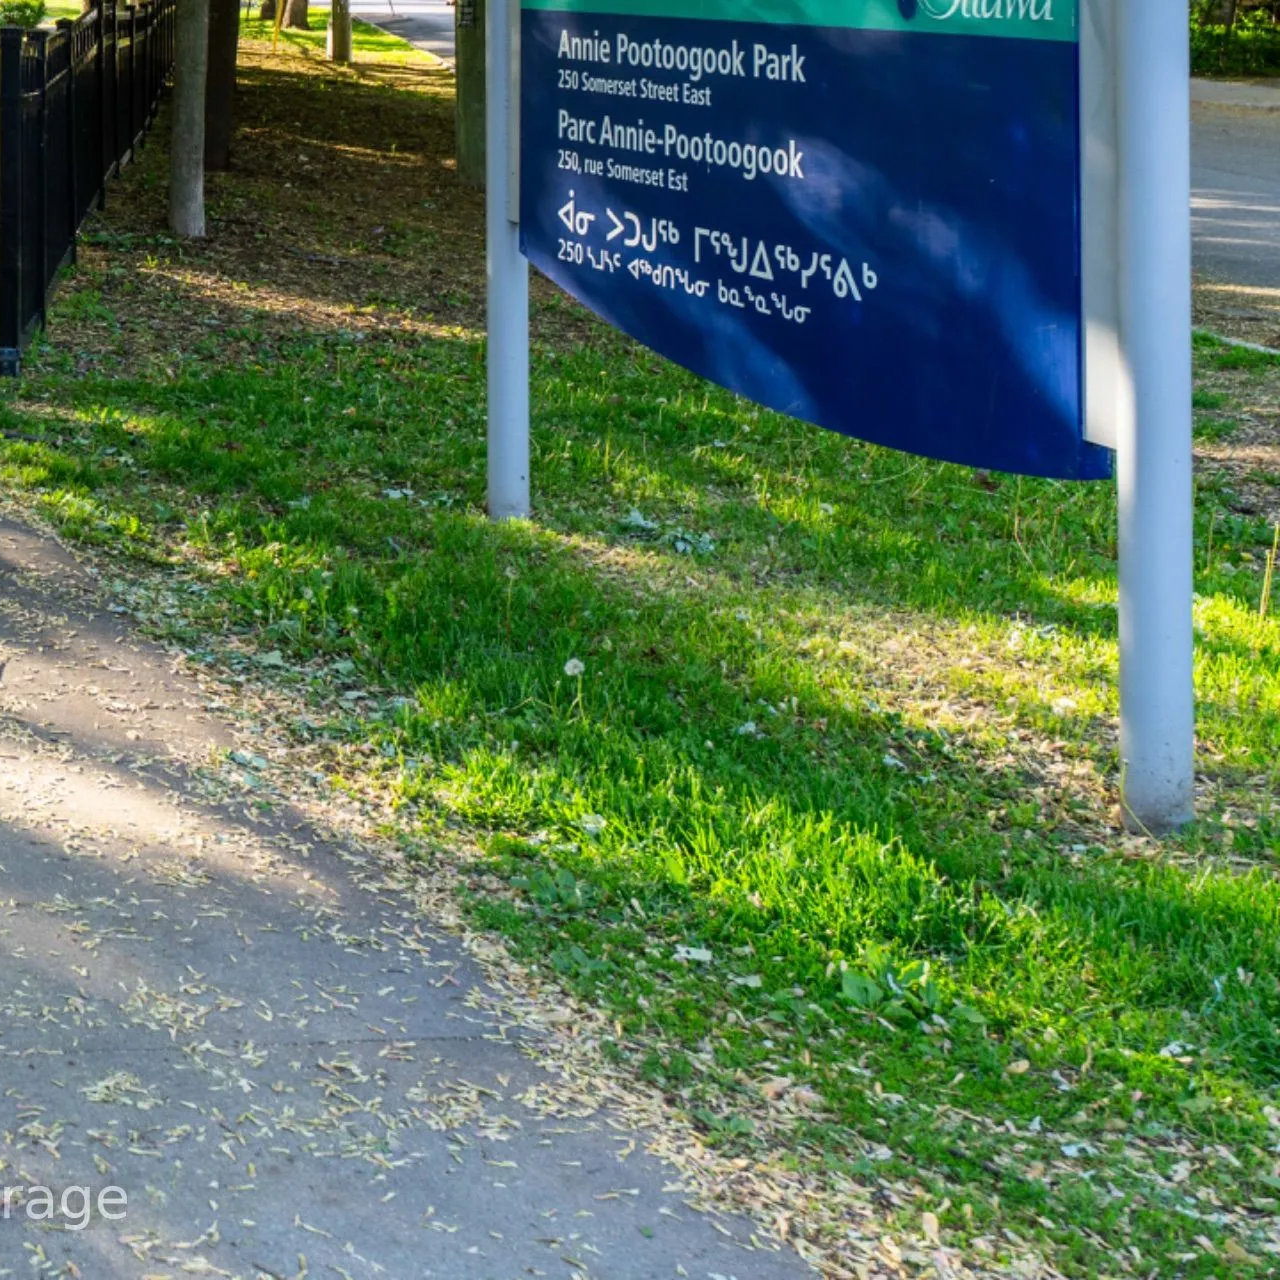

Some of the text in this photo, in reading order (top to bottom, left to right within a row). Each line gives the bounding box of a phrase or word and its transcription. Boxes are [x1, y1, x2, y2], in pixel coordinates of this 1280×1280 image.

[558, 29, 806, 83] Annie Pootoogook Park
[558, 69, 712, 107] 250 Somerset Street East
[558, 109, 805, 181] Parc Annie-Pootoogook
[558, 149, 689, 193] 250, rue Somerset Est
[557, 238, 584, 265] 250
